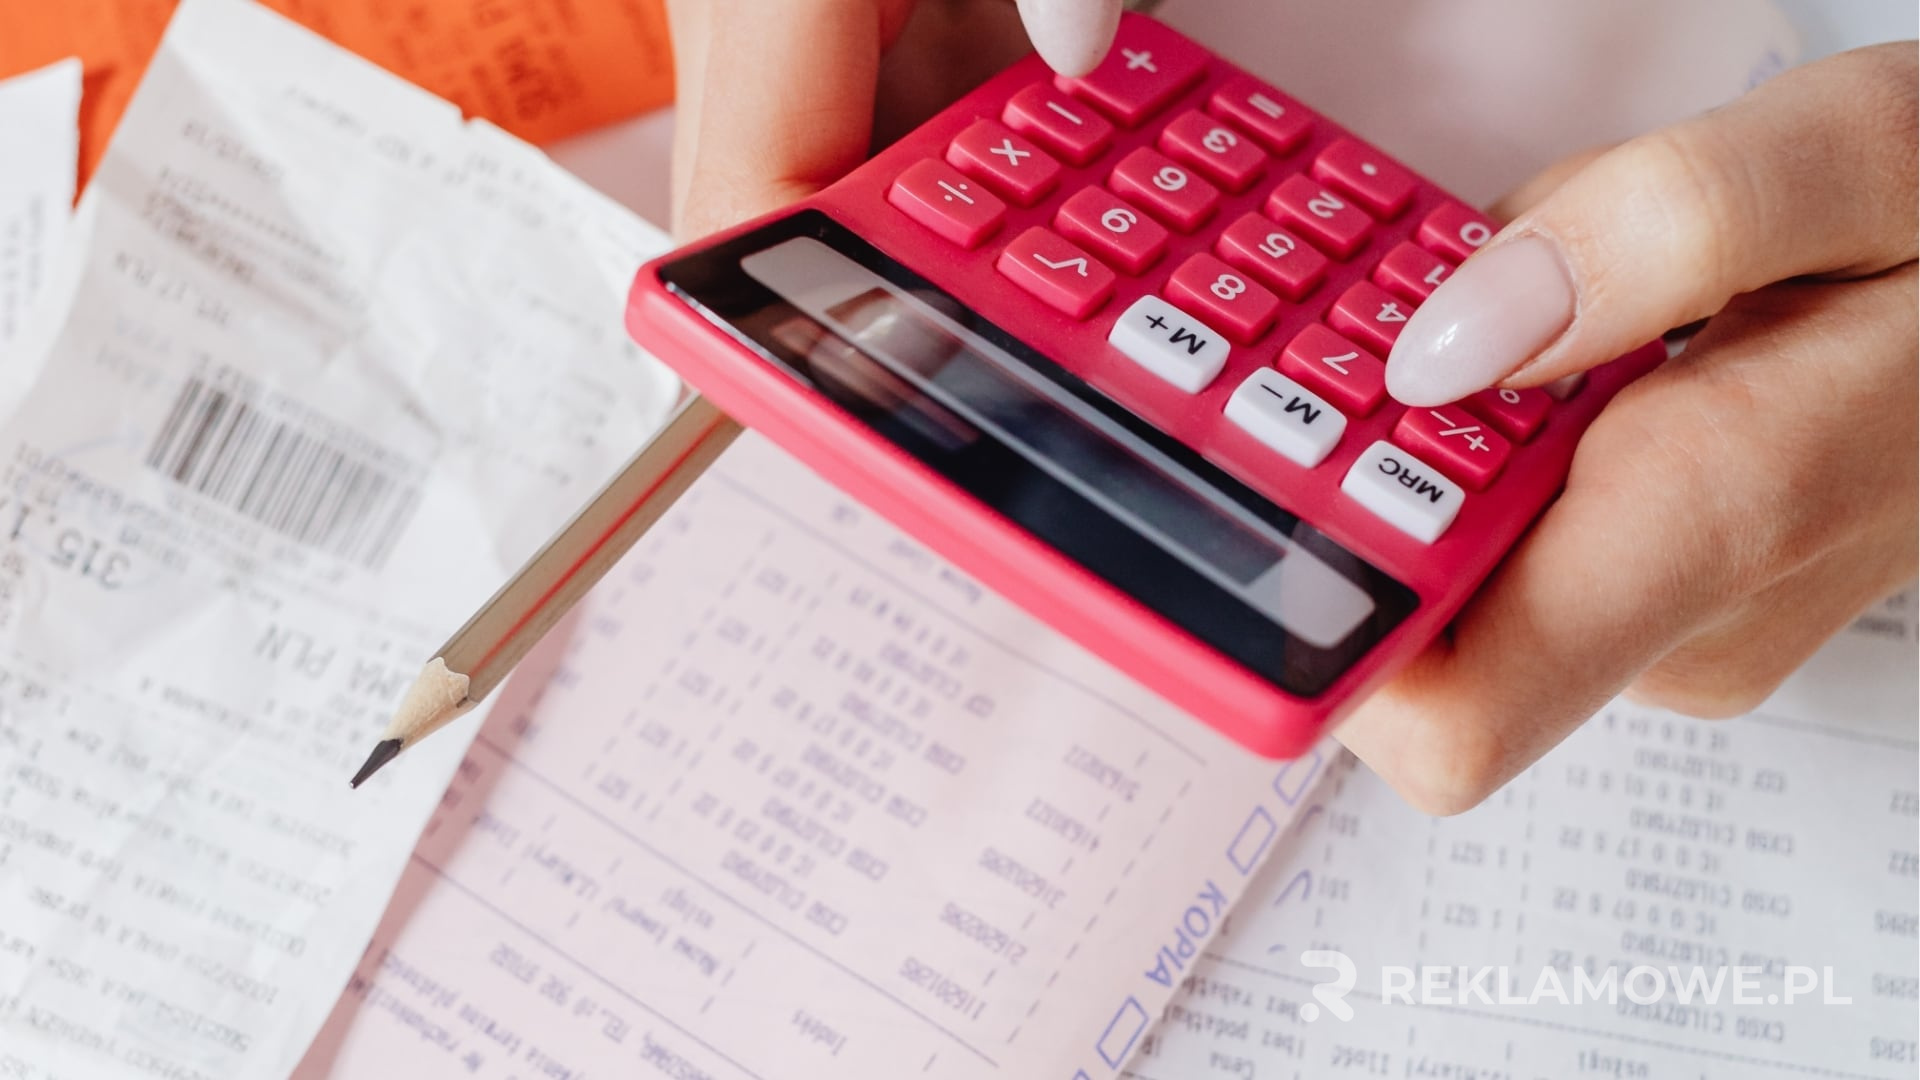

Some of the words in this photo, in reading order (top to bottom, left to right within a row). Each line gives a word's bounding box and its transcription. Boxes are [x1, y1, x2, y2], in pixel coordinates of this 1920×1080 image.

[1203, 128, 1237, 153] 3
[1308, 191, 1346, 219] 2
[1258, 232, 1295, 259] 5
[1210, 274, 1246, 300] 8
[1376, 302, 1408, 322] 4
[1321, 351, 1359, 375] 7
[1377, 456, 1444, 504] MRC
[1145, 879, 1228, 988] KOPIA
